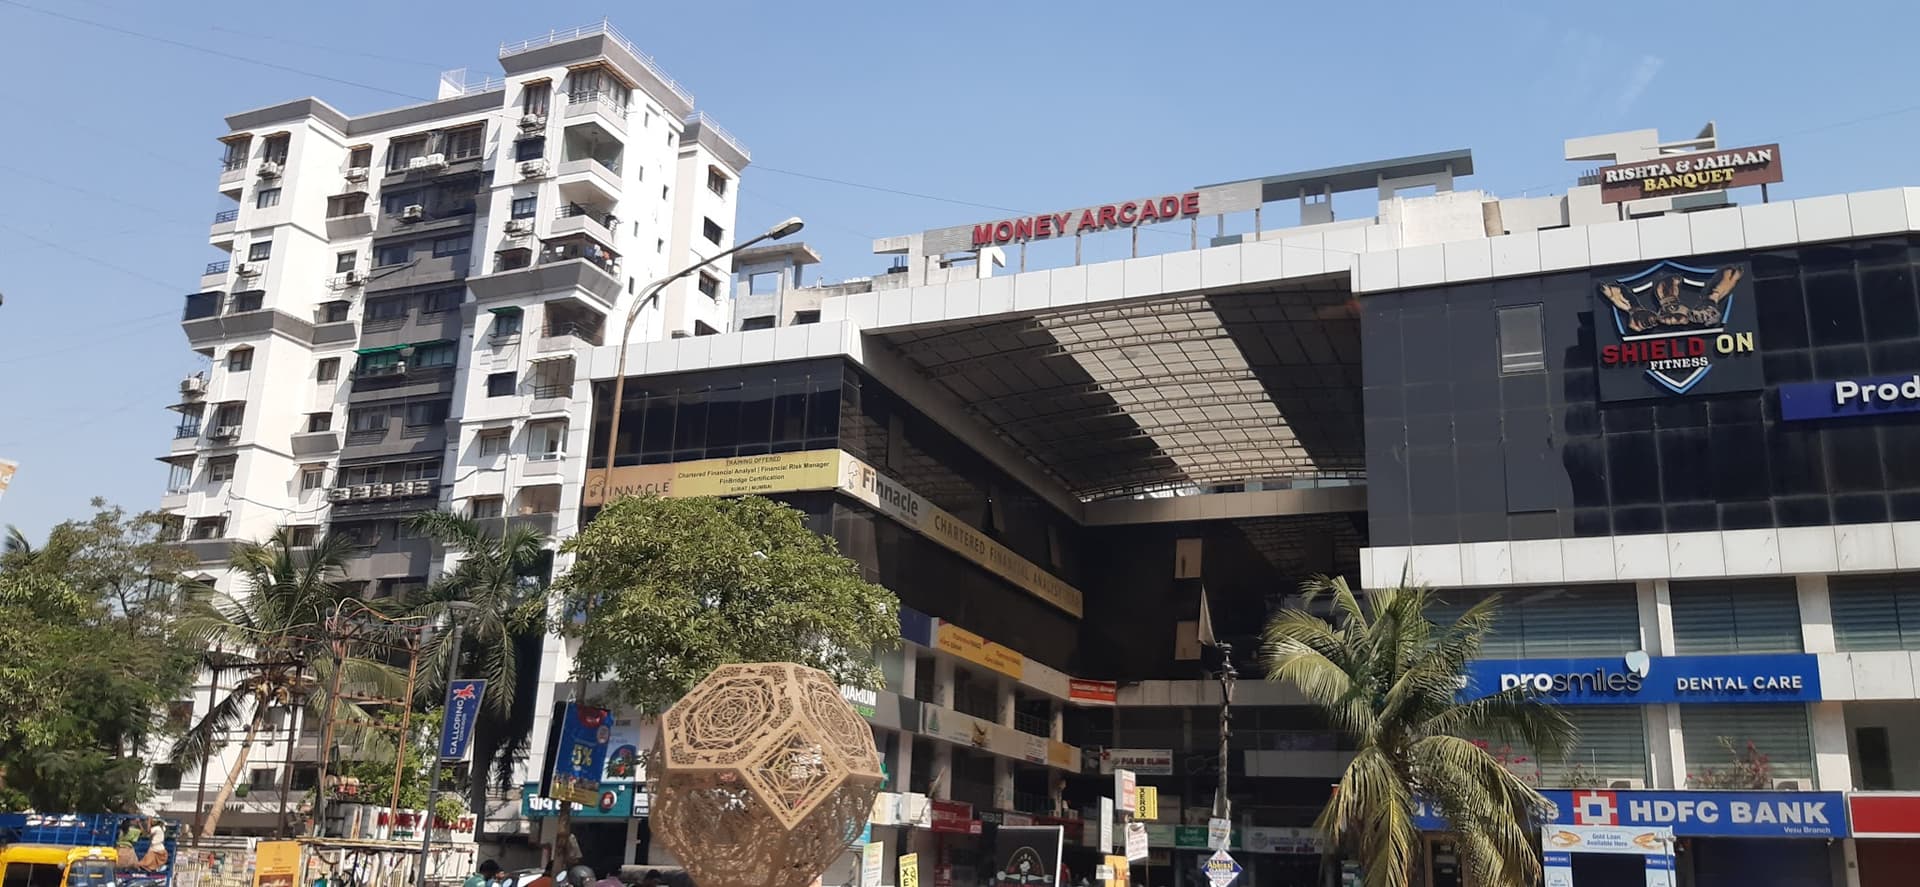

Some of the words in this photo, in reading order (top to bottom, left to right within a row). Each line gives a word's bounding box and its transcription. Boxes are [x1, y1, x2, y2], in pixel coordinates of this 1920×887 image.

[1605, 162, 1672, 183] RISHTA
[1675, 160, 1690, 173] &
[1693, 149, 1772, 170] JAHAAN
[1644, 168, 1735, 192] BANQUET
[972, 211, 1072, 246] MONEY
[1077, 192, 1200, 231] ARCADE
[1602, 337, 1706, 364] SHIELD
[1716, 332, 1754, 354] ON
[1650, 356, 1709, 371] FITNESS
[1835, 375, 1920, 405] Prod
[678, 471, 706, 479] Chartered
[707, 469, 734, 477] Financial
[734, 466, 757, 475] Analyst
[761, 464, 787, 473] Financial
[803, 461, 830, 470] Manager
[754, 456, 782, 464] OFFERED
[720, 476, 748, 485] FinBridge
[749, 473, 785, 482] Certification
[861, 467, 919, 517] Finnacle
[934, 514, 986, 556] CHARTERED
[1501, 667, 1642, 693] prosmiles
[1677, 676, 1749, 691] DENTAL
[1753, 675, 1803, 690] CARE
[450, 700, 464, 755] GALLOPING
[377, 812, 423, 829] MNEY
[1629, 800, 1719, 823] HDFC
[1730, 801, 1829, 824] BANK
[1784, 826, 1802, 834] Vesu
[1803, 826, 1831, 834] Branch
[1587, 839, 1613, 847] Available
